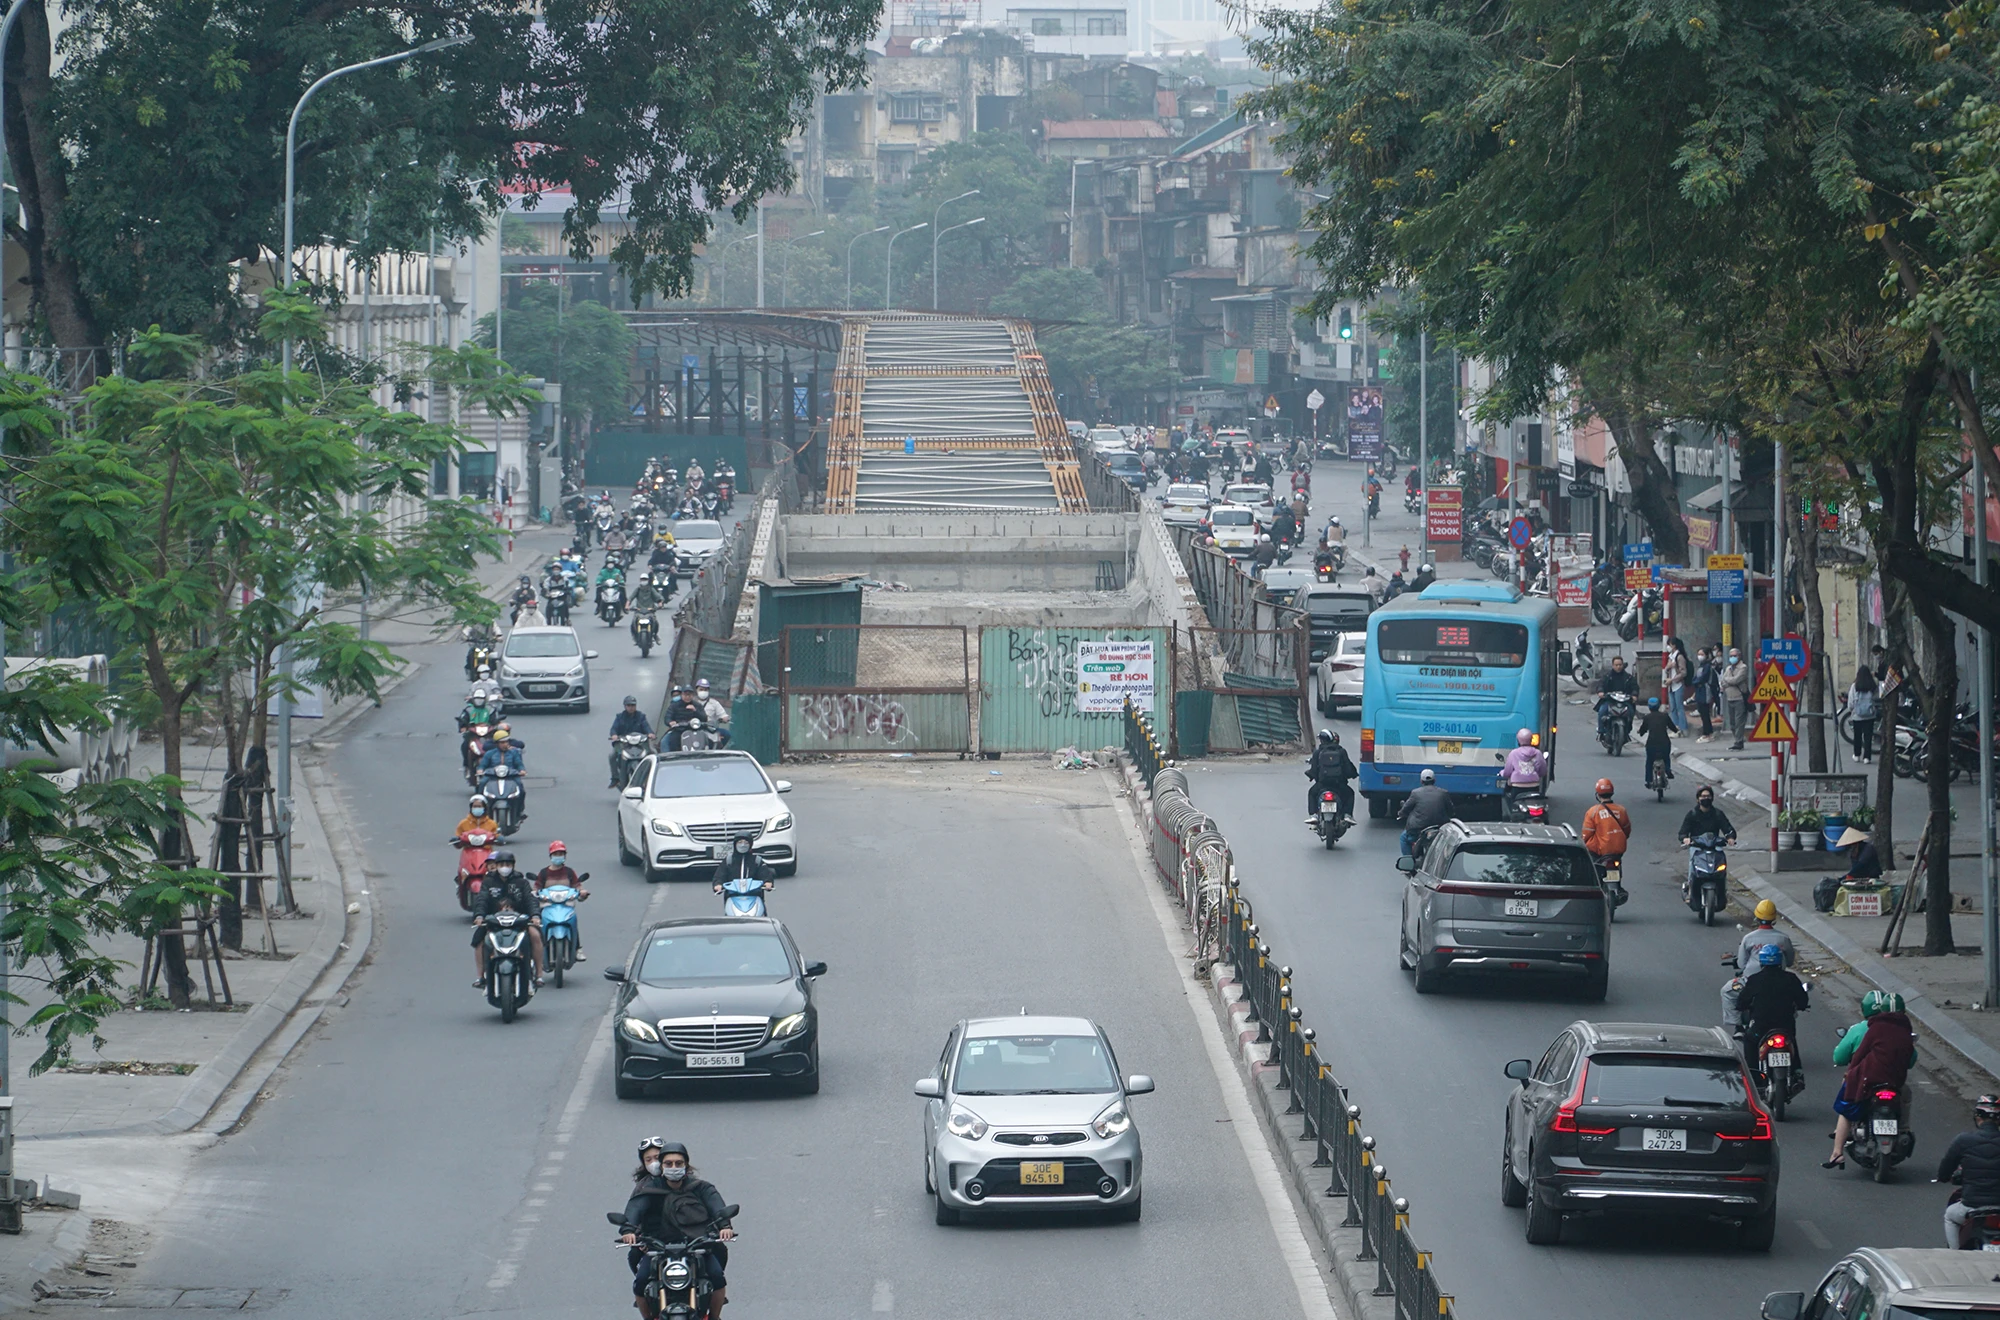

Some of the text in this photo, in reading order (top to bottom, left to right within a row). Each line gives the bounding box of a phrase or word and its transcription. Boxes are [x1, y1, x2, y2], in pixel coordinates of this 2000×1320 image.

[1430, 527, 1459, 535] 1.200K
[1125, 653, 1136, 661] HỌC
[1430, 668, 1438, 676] XE
[1125, 673, 1148, 681] HƠN
[1768, 674, 1778, 683] ĐI
[1423, 722, 1477, 734] 29B-401.40
[1851, 895, 1863, 903] CƠM
[1509, 907, 1534, 915] 815.75
[691, 1056, 740, 1065] 30G-565.18
[1629, 1113, 1703, 1121] VOLVO
[1656, 1130, 1674, 1139] 30K
[1648, 1140, 1682, 1150] 247.29
[1033, 1164, 1051, 1173] 30E
[1025, 1174, 1059, 1183] 945.19
